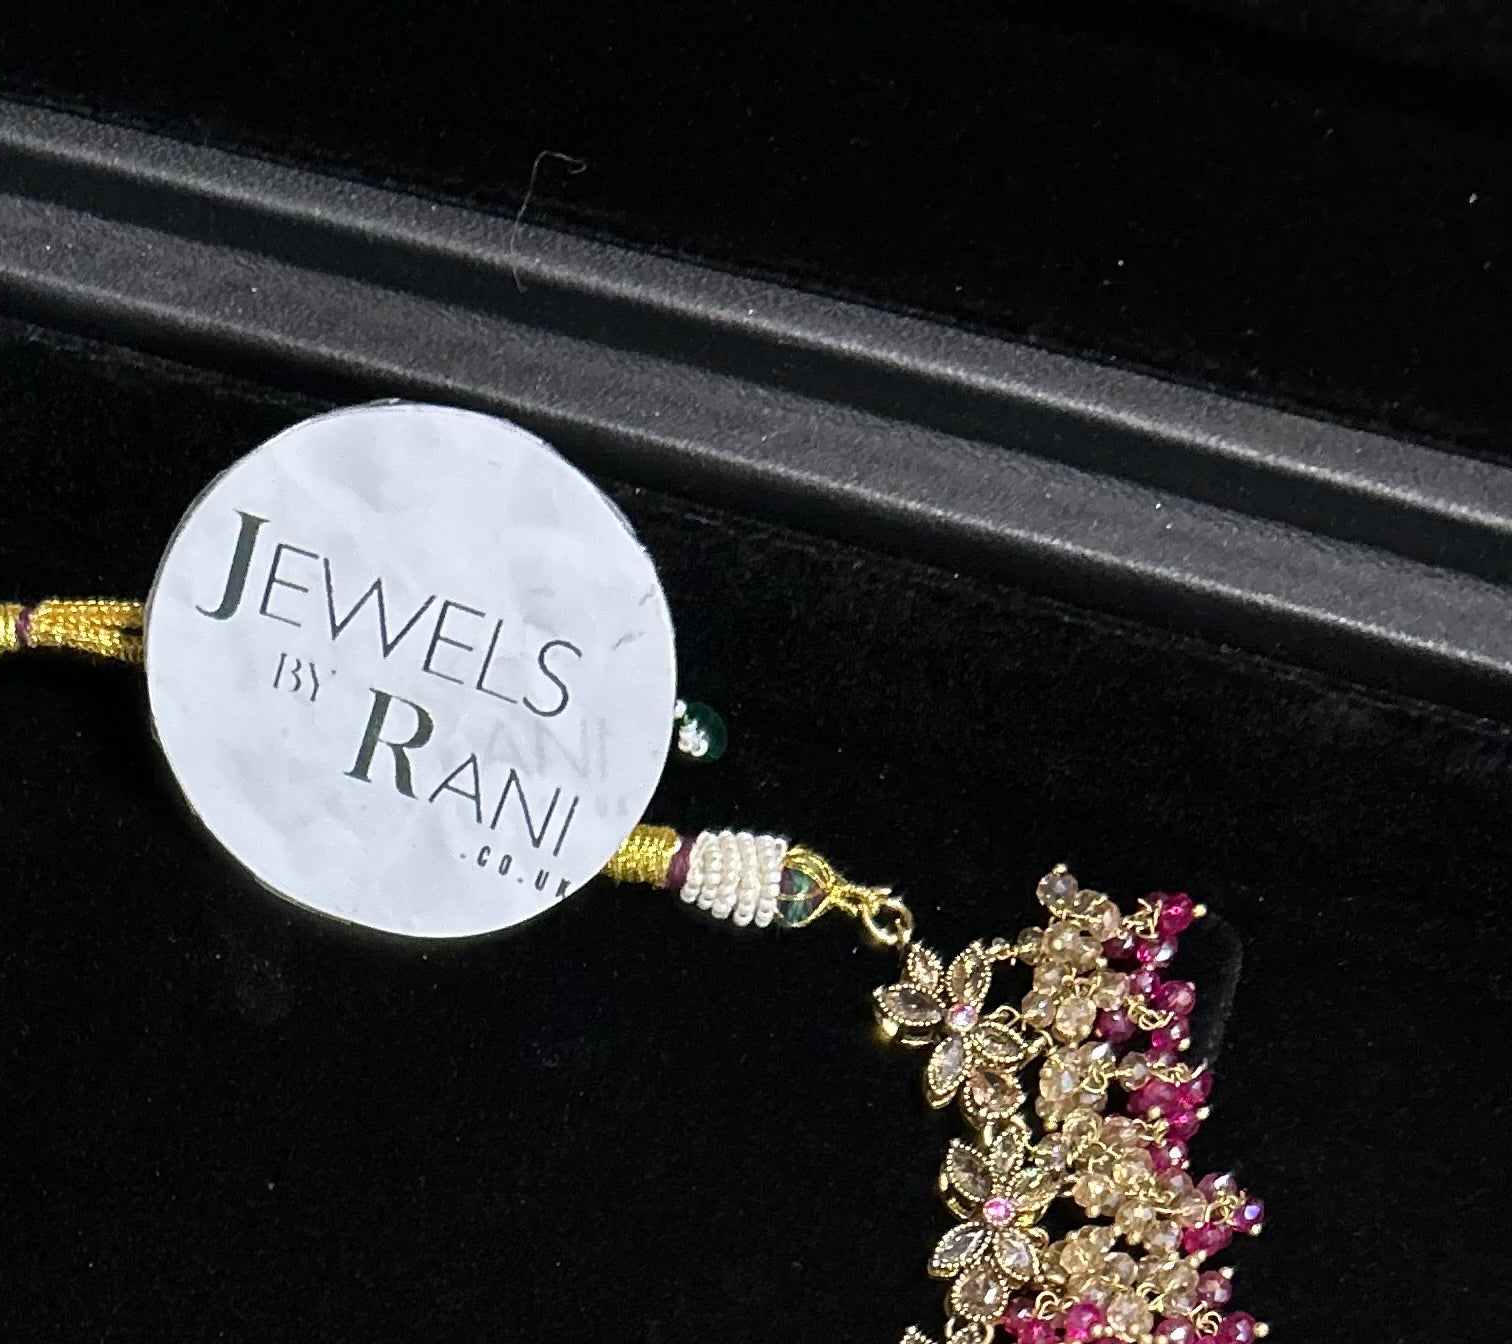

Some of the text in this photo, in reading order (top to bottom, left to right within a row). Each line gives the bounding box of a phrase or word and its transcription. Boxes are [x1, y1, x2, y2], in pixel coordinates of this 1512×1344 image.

[195, 508, 582, 718] JEWELS
[273, 652, 579, 857] BY RANI
